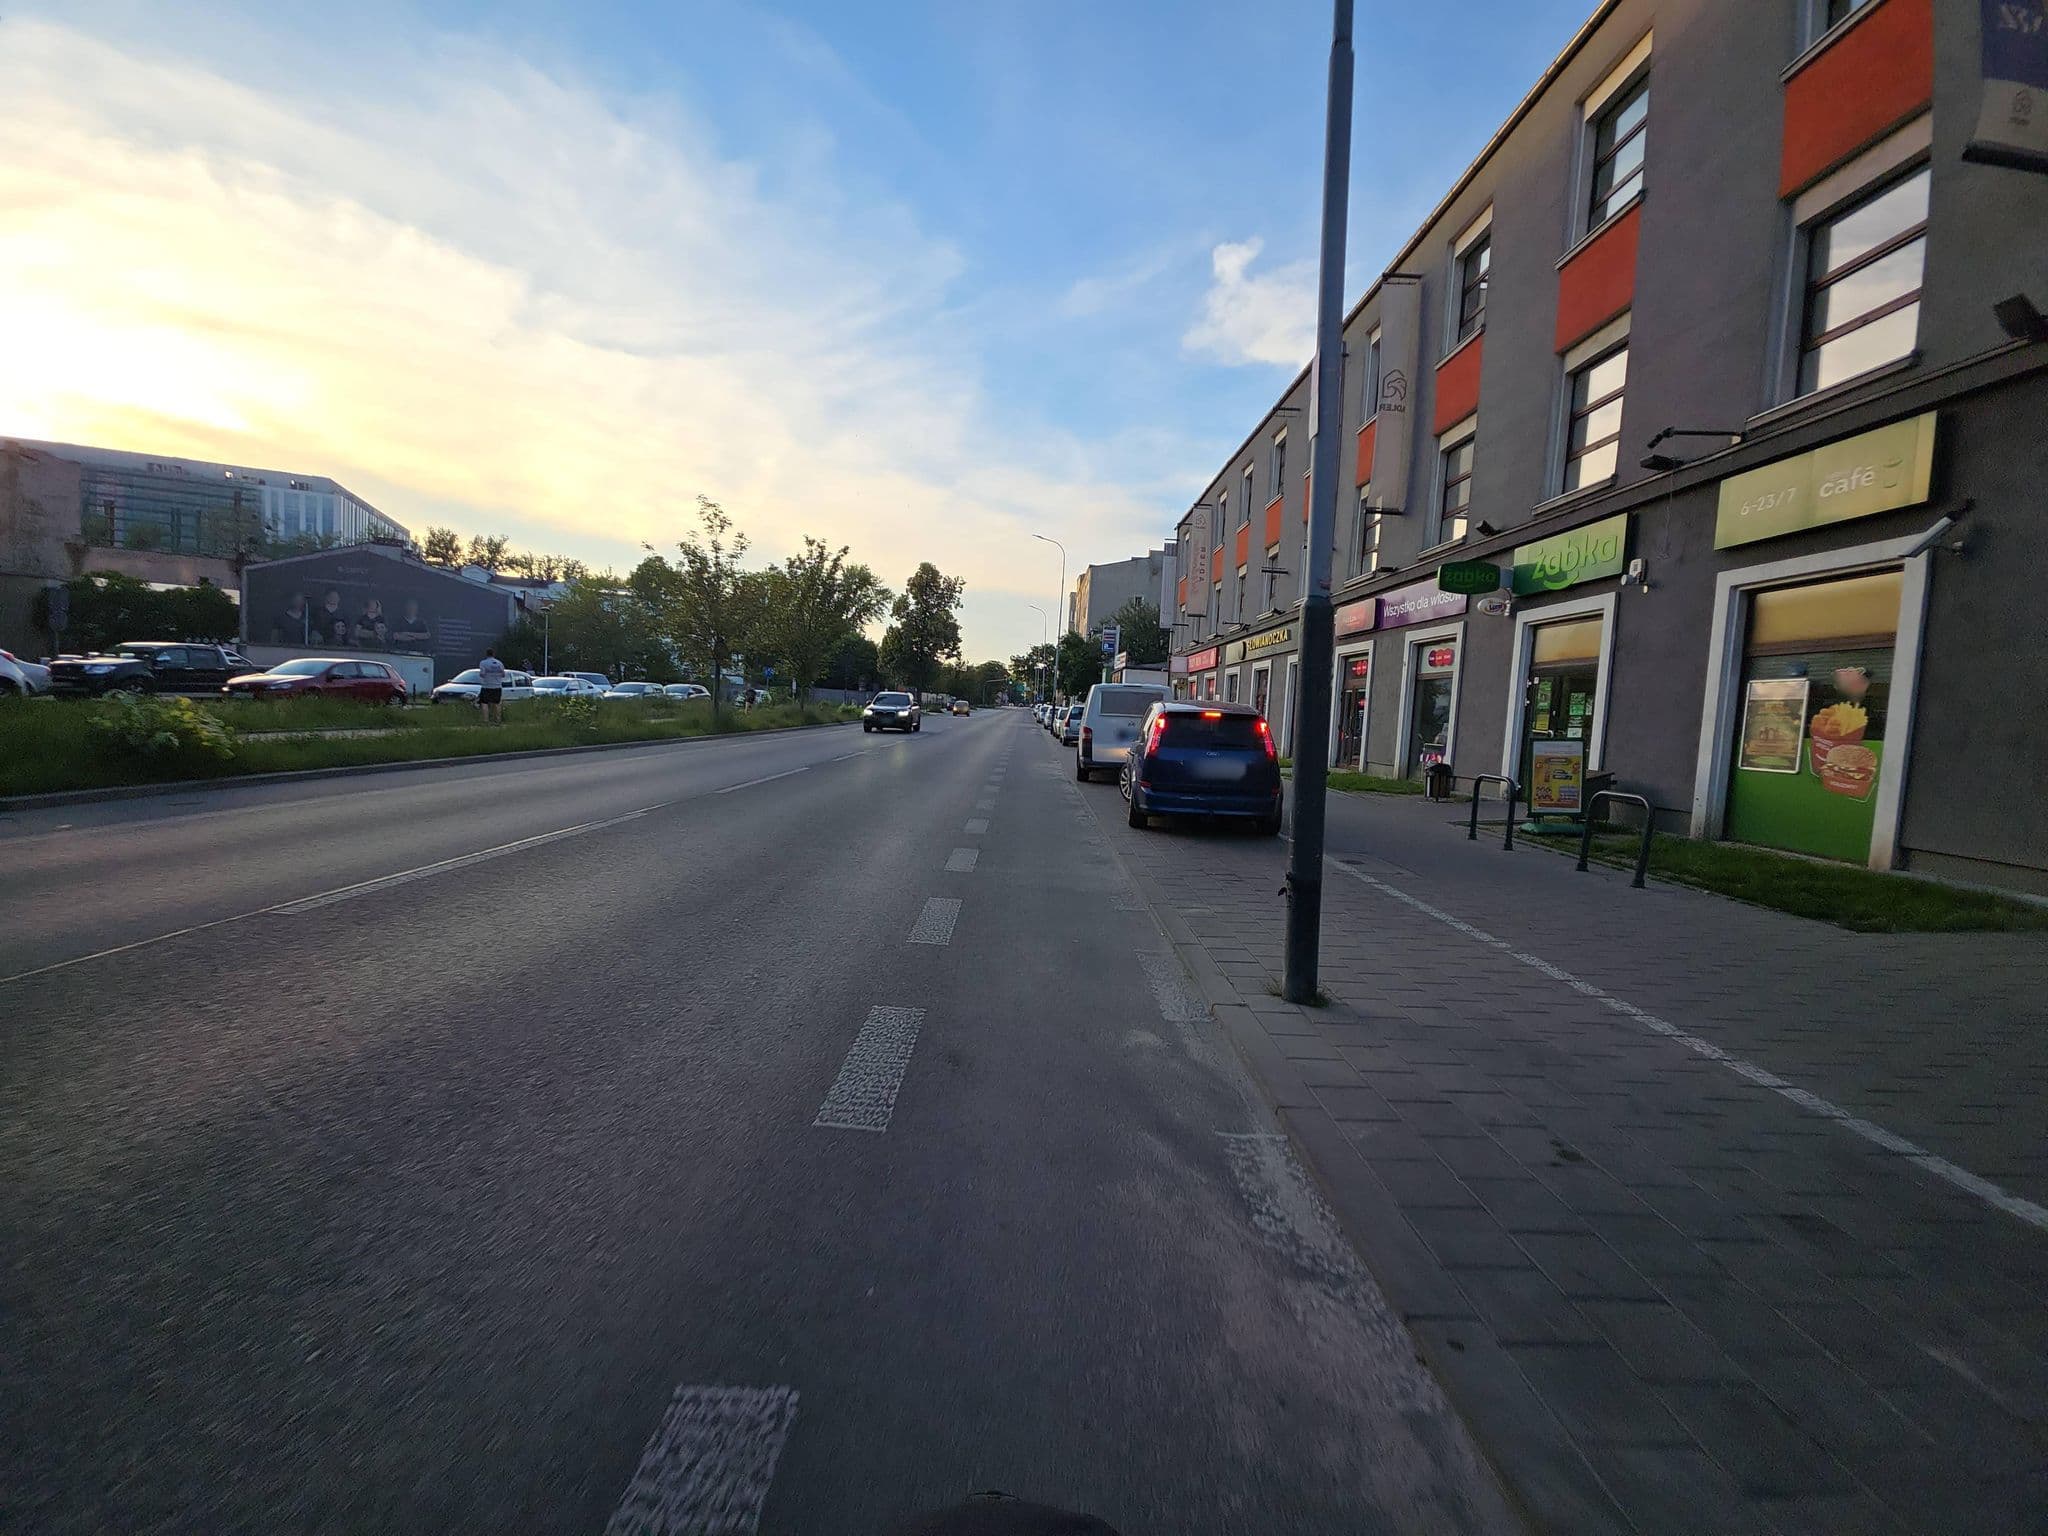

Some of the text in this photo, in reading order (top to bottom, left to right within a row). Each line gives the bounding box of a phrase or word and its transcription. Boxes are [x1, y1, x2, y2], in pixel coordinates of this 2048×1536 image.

[1740, 465, 1875, 516] 6-23/7 café
[1532, 533, 1618, 580] żabka
[1384, 600, 1415, 618] Wszystko
[1417, 596, 1428, 610] dla
